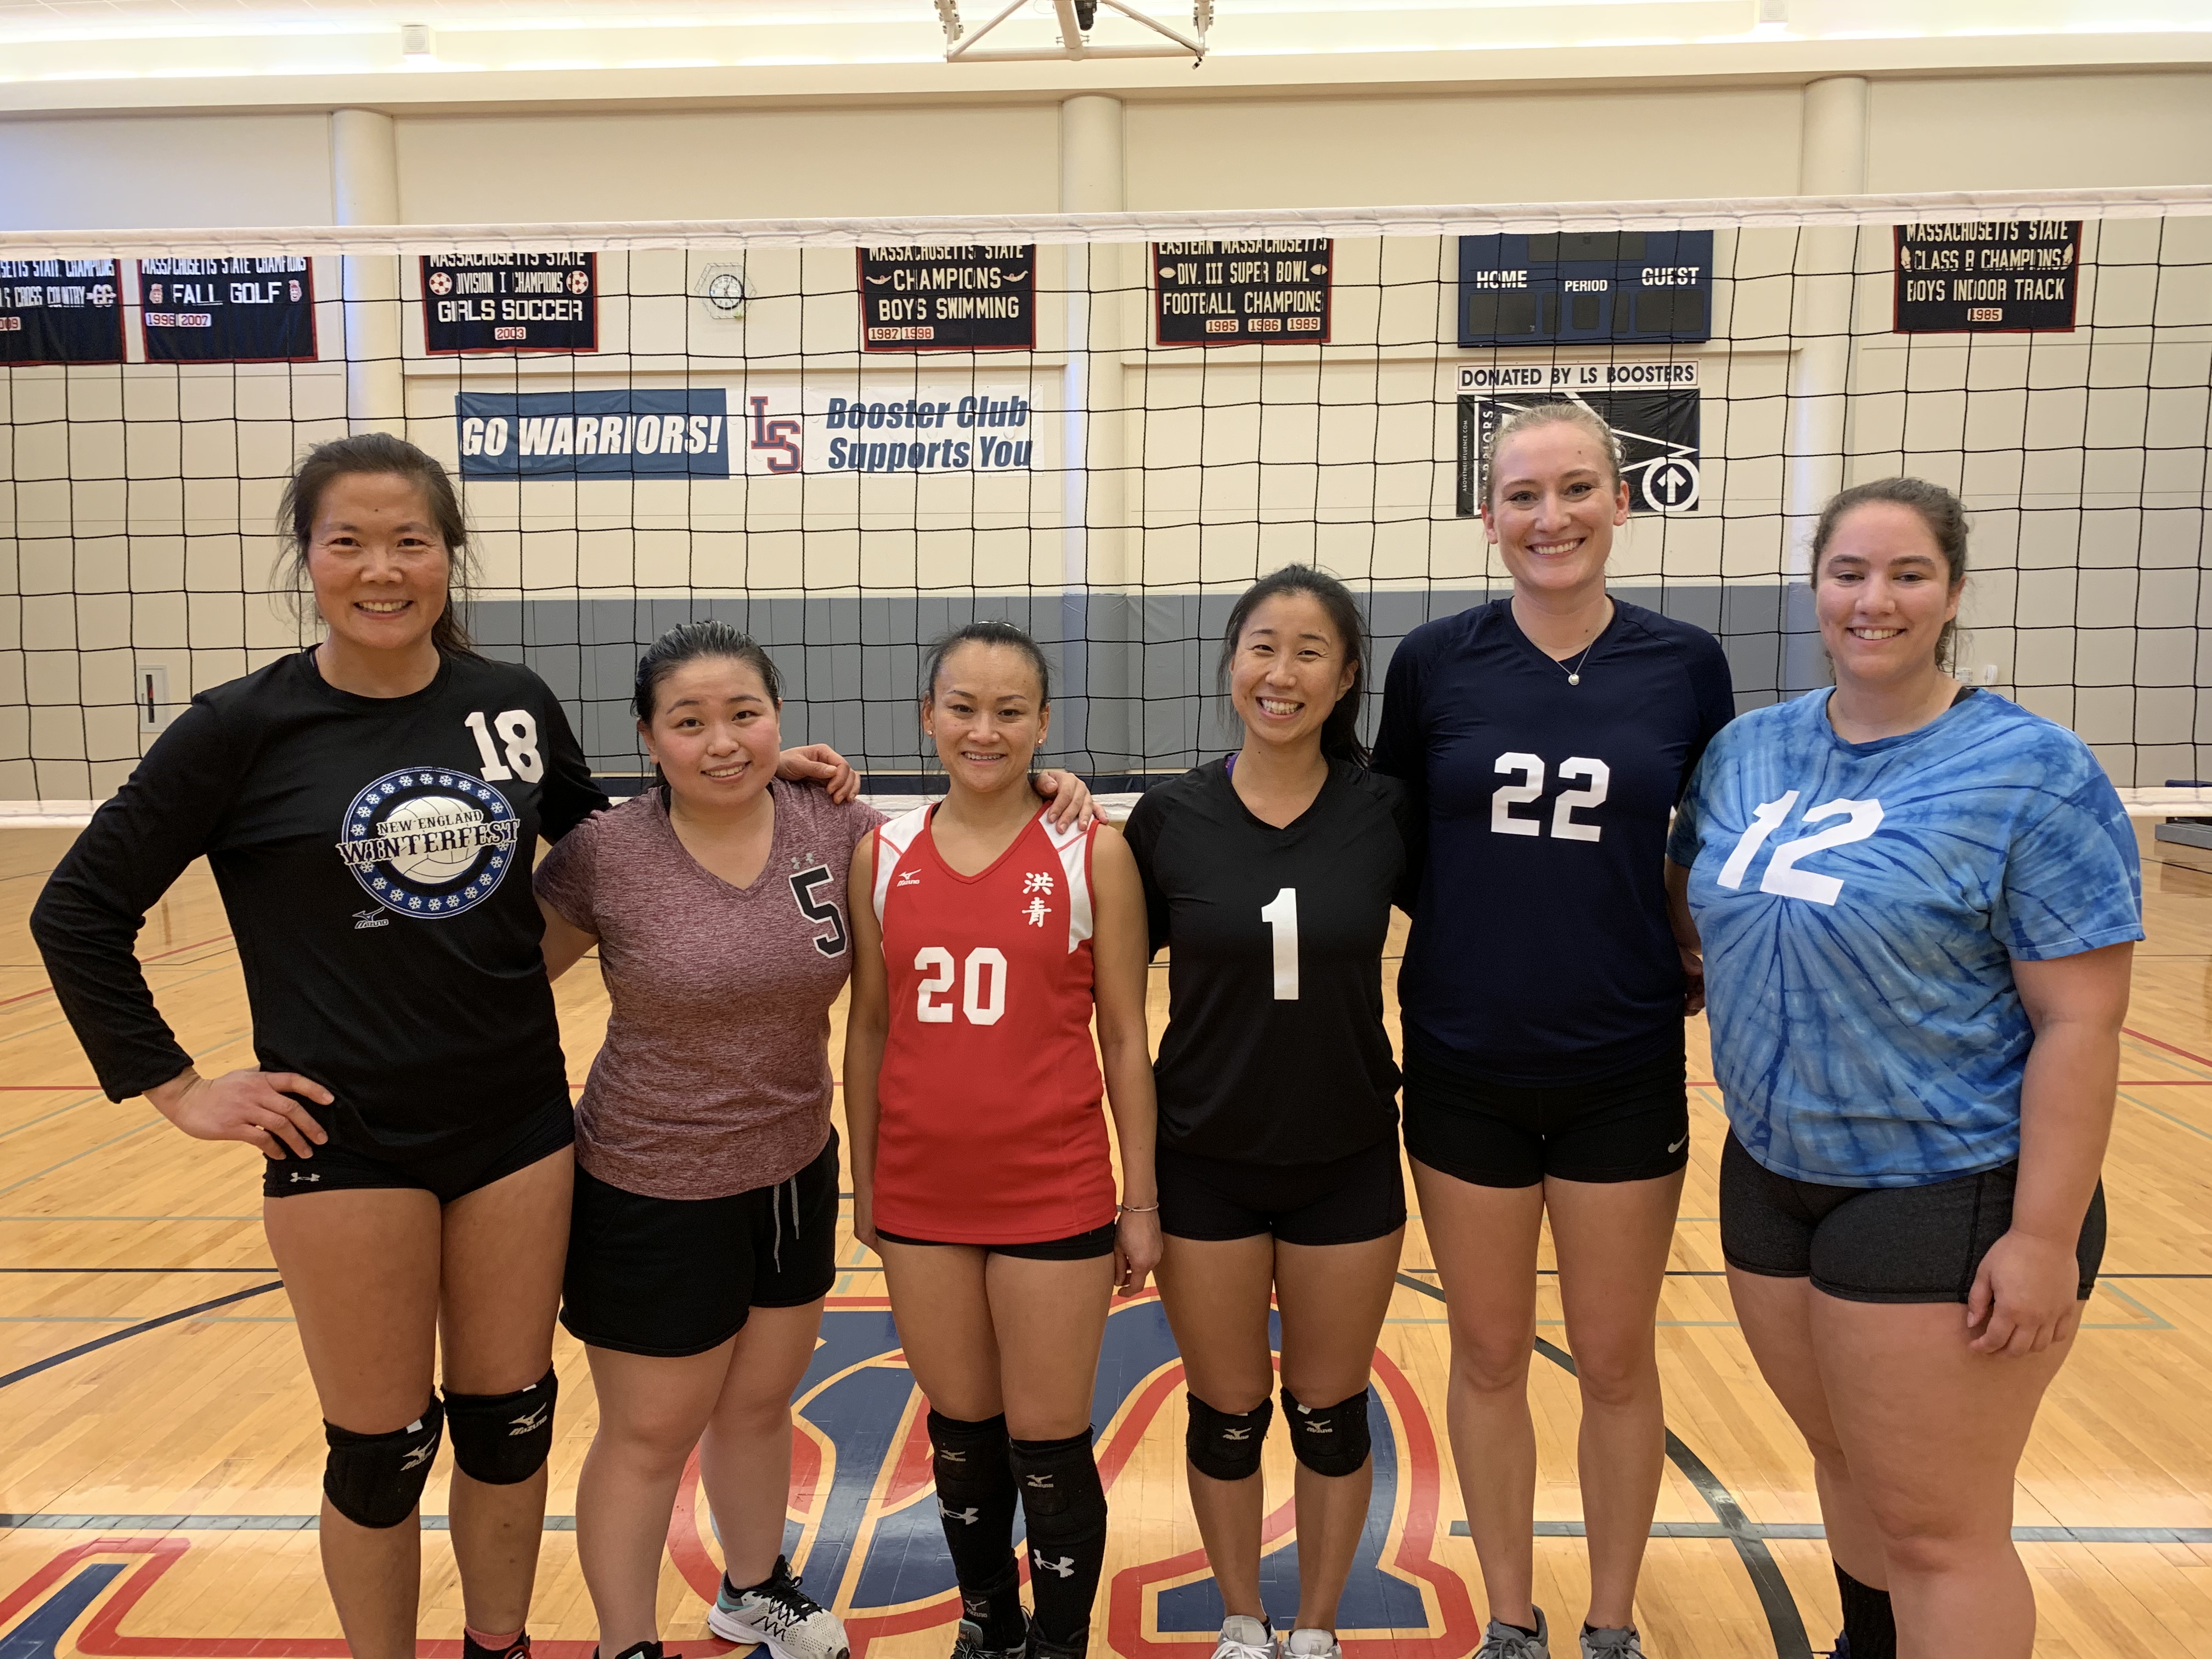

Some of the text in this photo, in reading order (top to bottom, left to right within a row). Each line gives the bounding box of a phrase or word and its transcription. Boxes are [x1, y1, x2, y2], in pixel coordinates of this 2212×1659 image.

[1906, 221, 2068, 242] MASSACHUSETTS STATE
[869, 245, 1024, 261] MASSACHUSETTS STATE
[1159, 239, 1327, 255] EASTERN MASSACHUSETTS
[430, 252, 586, 268] MASSACHUSETTS STATE
[1915, 250, 1960, 272] CLASS
[1981, 248, 2062, 271] CHAMPIONS
[456, 272, 563, 295] DIVISION I CHAMPIONS
[893, 267, 1001, 291] CHAMPIONS
[1177, 261, 1310, 285] DIV. III SUPER BOWL
[1476, 270, 1528, 289] HOME
[1641, 267, 1700, 286] GUEST
[14, 286, 43, 307] CROSS
[47, 286, 85, 307] COUNTRY
[172, 281, 282, 306] FALL GOLF
[1565, 280, 1608, 292] PERIOD
[1906, 278, 2066, 302] BOYS INDOOR TRACK
[438, 299, 583, 323] GIRLS SOCCER
[878, 296, 1019, 321] BOYS SWIMMING
[1163, 290, 1324, 315] FOOTBALL CHAMPIONS
[1970, 308, 2000, 320] 1985
[181, 314, 208, 326] 2007
[1207, 318, 1318, 332] 1985 1986 1989
[496, 328, 524, 339] 2003
[871, 328, 932, 340] 1987 1998
[1462, 365, 1695, 386] DONATED BY LS BOOSTERS
[826, 395, 1028, 429] Booster Club
[460, 415, 723, 456] GO WARRIORS!
[750, 396, 800, 473] LS
[828, 436, 1033, 472] Supports You
[464, 709, 544, 783] 18
[1491, 752, 1610, 842] 22
[378, 810, 483, 836] NEW ENGLAND
[336, 819, 520, 865] WINTERFEST
[1717, 790, 1885, 906] 12
[788, 864, 847, 958] 5
[1022, 871, 1054, 928] 洪青
[1261, 887, 1299, 1000] 1
[914, 946, 1008, 1025] 20
